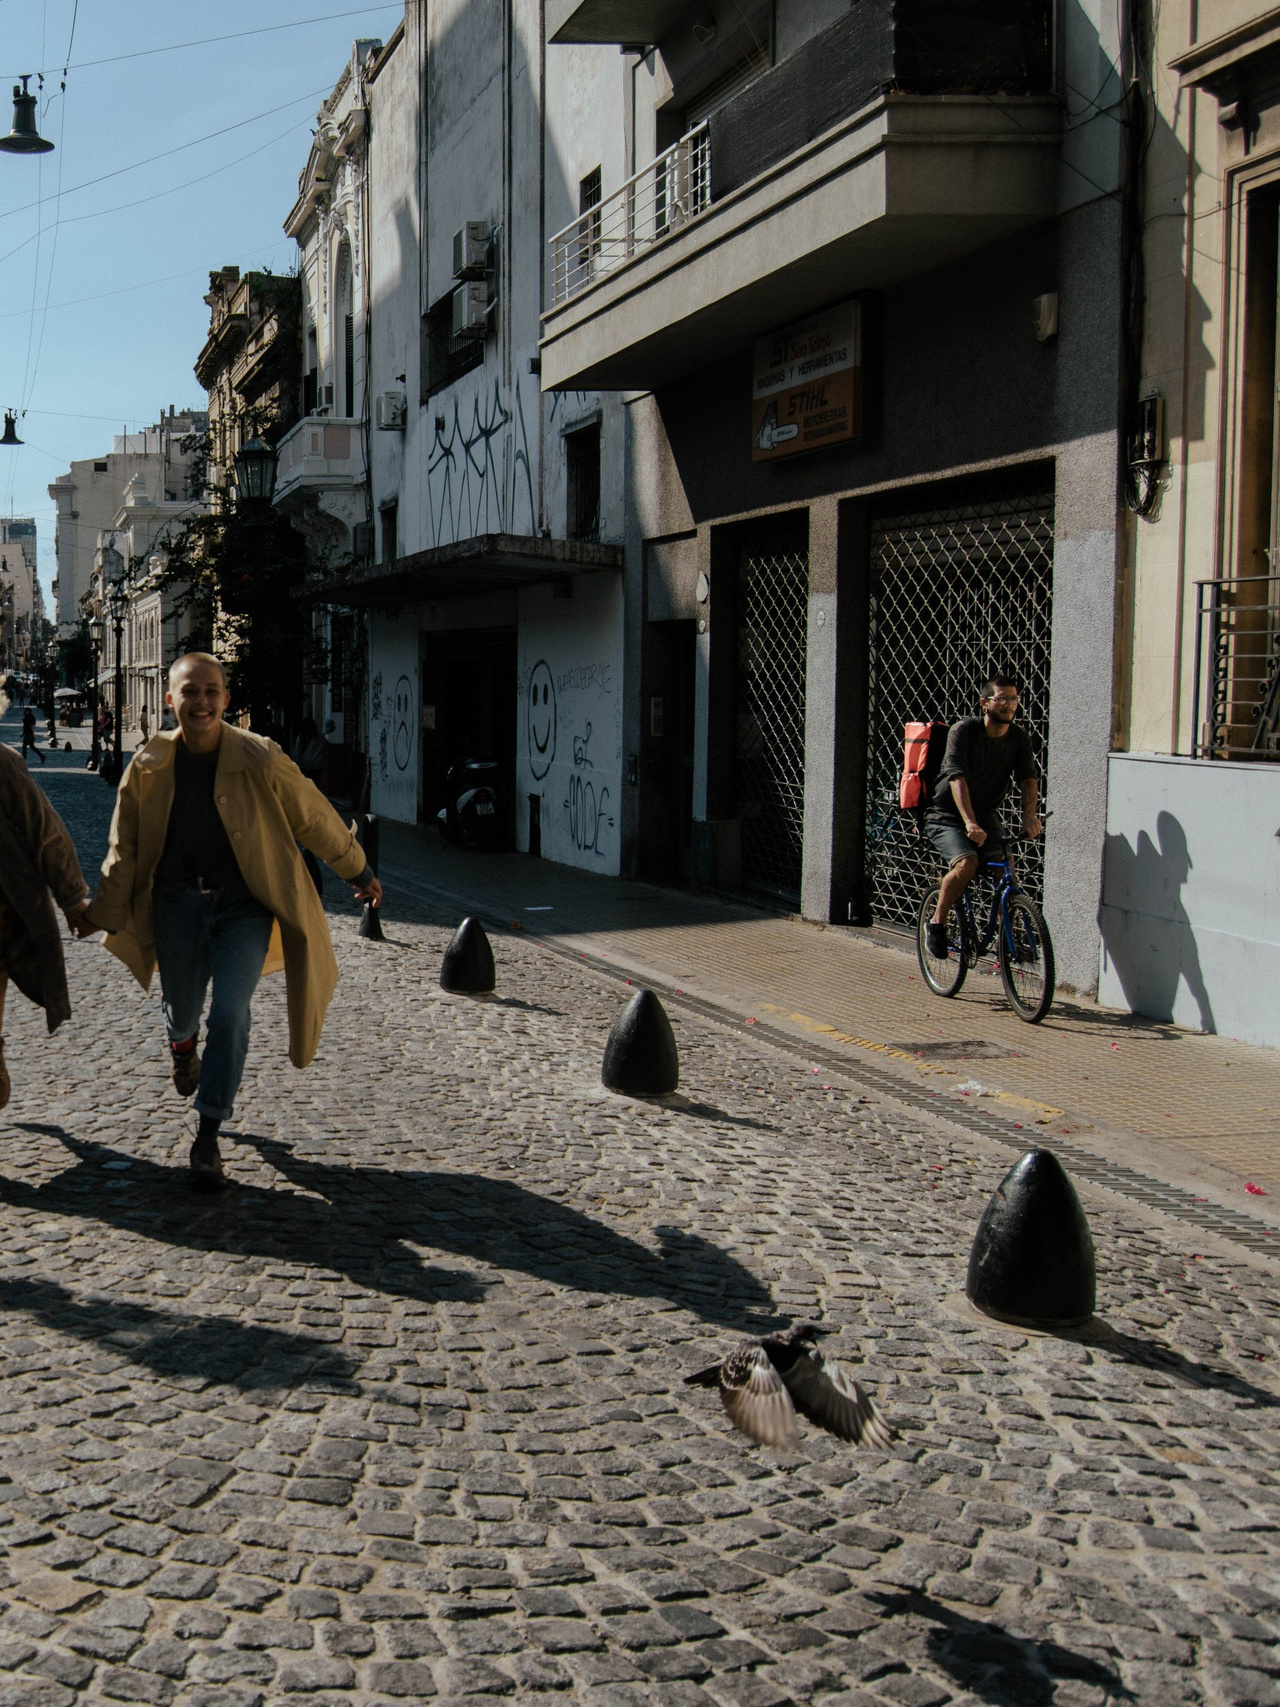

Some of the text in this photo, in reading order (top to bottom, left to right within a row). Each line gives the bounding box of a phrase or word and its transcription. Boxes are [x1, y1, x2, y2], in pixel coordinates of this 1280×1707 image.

[789, 366, 794, 379] Y
[798, 347, 847, 376] HERRAMIENTAS
[787, 384, 829, 417] STIHL
